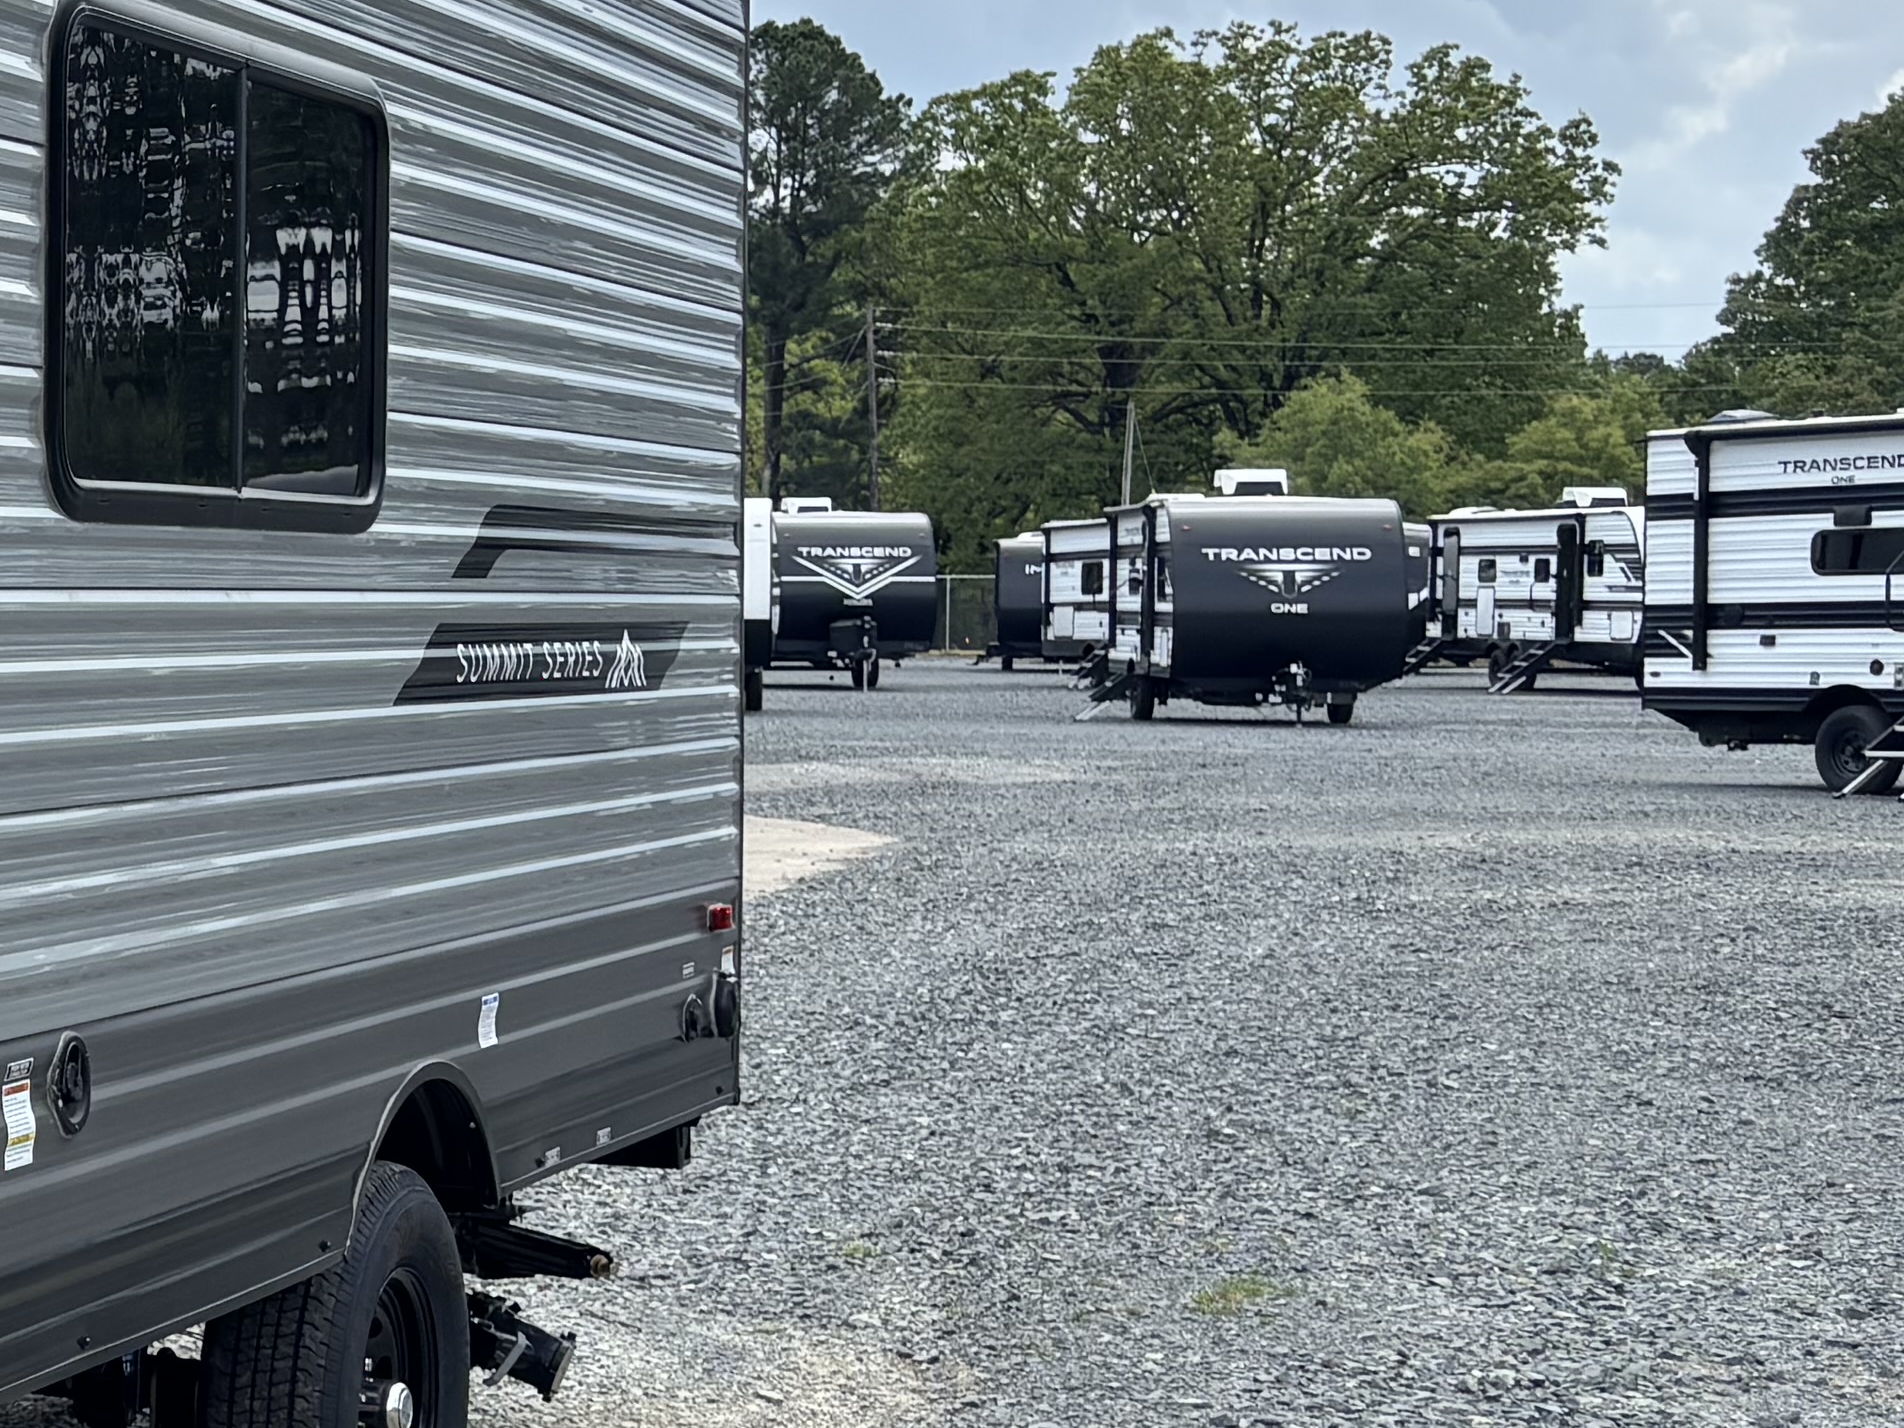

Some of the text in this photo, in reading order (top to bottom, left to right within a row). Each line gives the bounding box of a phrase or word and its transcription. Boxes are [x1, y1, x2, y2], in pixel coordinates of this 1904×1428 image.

[1831, 475, 1856, 485] ONE
[797, 546, 912, 558] TRANSCEND
[1201, 546, 1373, 562] TRANSCEND
[1270, 602, 1309, 615] ONE
[455, 640, 603, 683] SUMMIT SERIES
